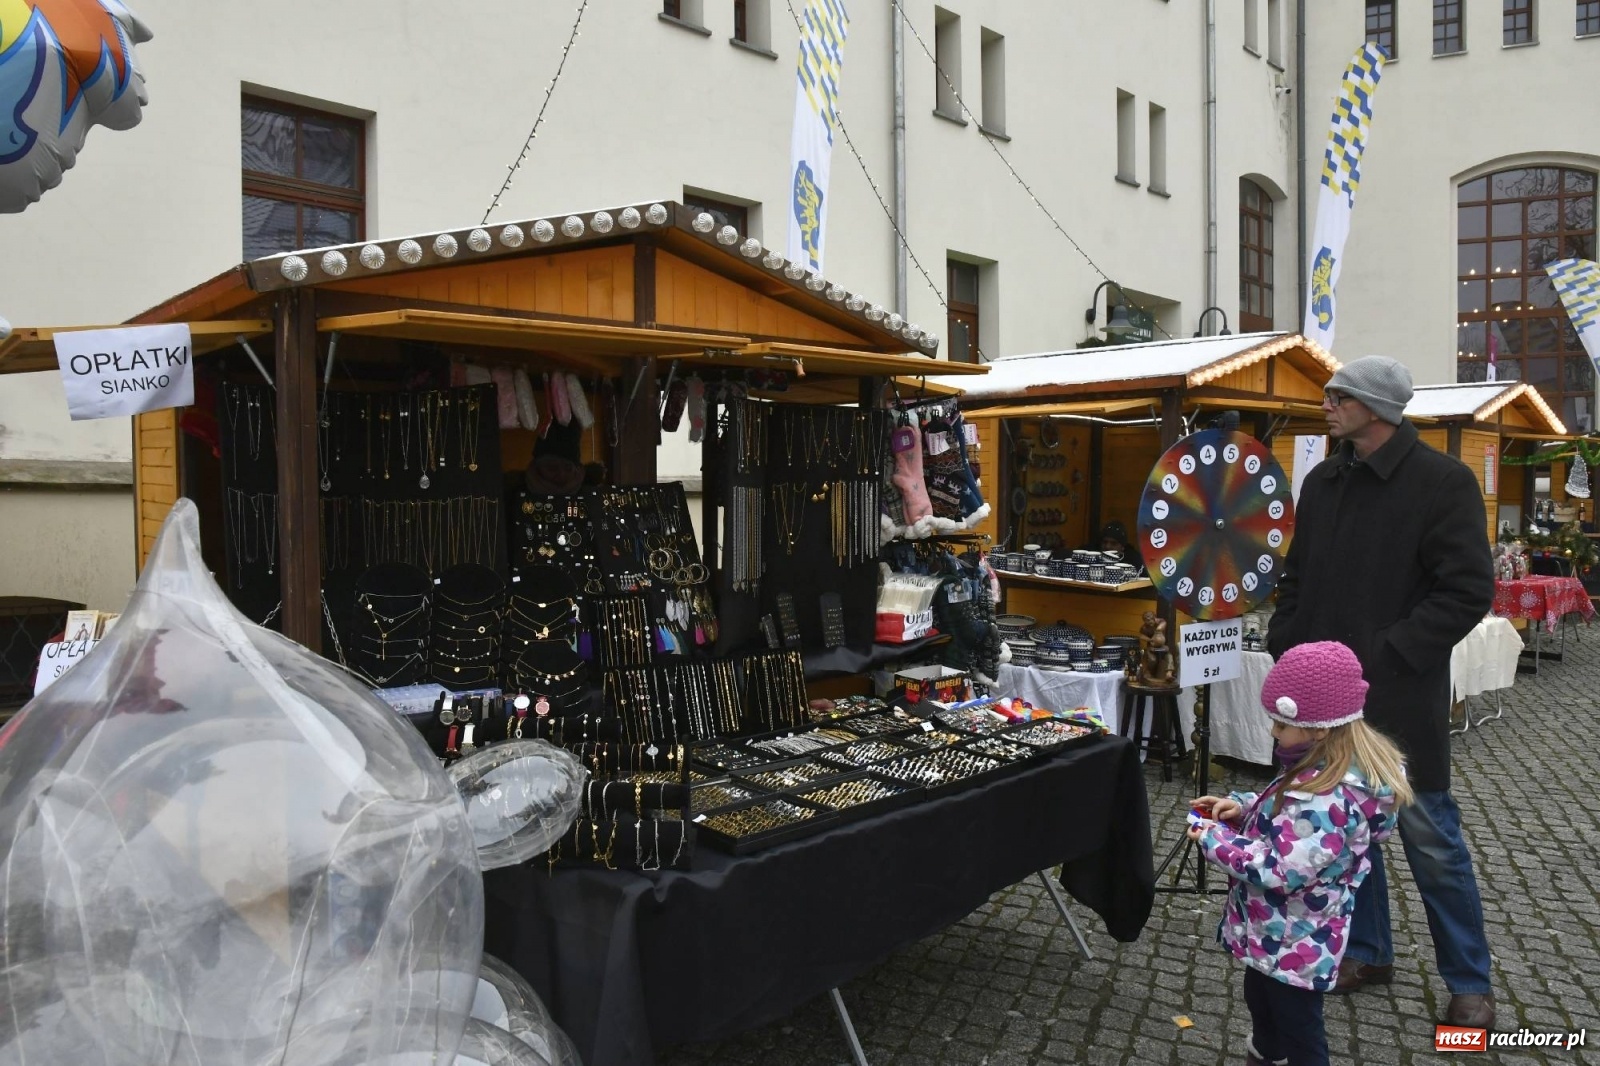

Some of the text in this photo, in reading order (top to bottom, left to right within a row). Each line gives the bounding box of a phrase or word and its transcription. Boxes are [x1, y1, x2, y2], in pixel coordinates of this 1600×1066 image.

[70, 346, 188, 376] OPŁATKI
[100, 374, 170, 395] SIANKO
[1204, 448, 1212, 460] 4
[1227, 447, 1236, 460] 5
[1182, 458, 1192, 471] 3
[1247, 459, 1258, 471] 6
[1164, 478, 1177, 490] 2
[1263, 479, 1275, 490] 7
[1155, 506, 1166, 514] 1
[1270, 506, 1282, 515] 8
[1153, 529, 1165, 547] 16
[1270, 533, 1280, 543] 9
[1161, 558, 1175, 575] 15
[1258, 556, 1272, 572] 10
[1178, 579, 1192, 595] 14
[1243, 574, 1257, 590] 11
[1200, 589, 1213, 602] 13
[1223, 586, 1238, 600] 12
[1184, 626, 1239, 643] KAŻDY LOS
[1186, 641, 1236, 657] WYGRYWA
[1203, 666, 1220, 678] 5 zł
